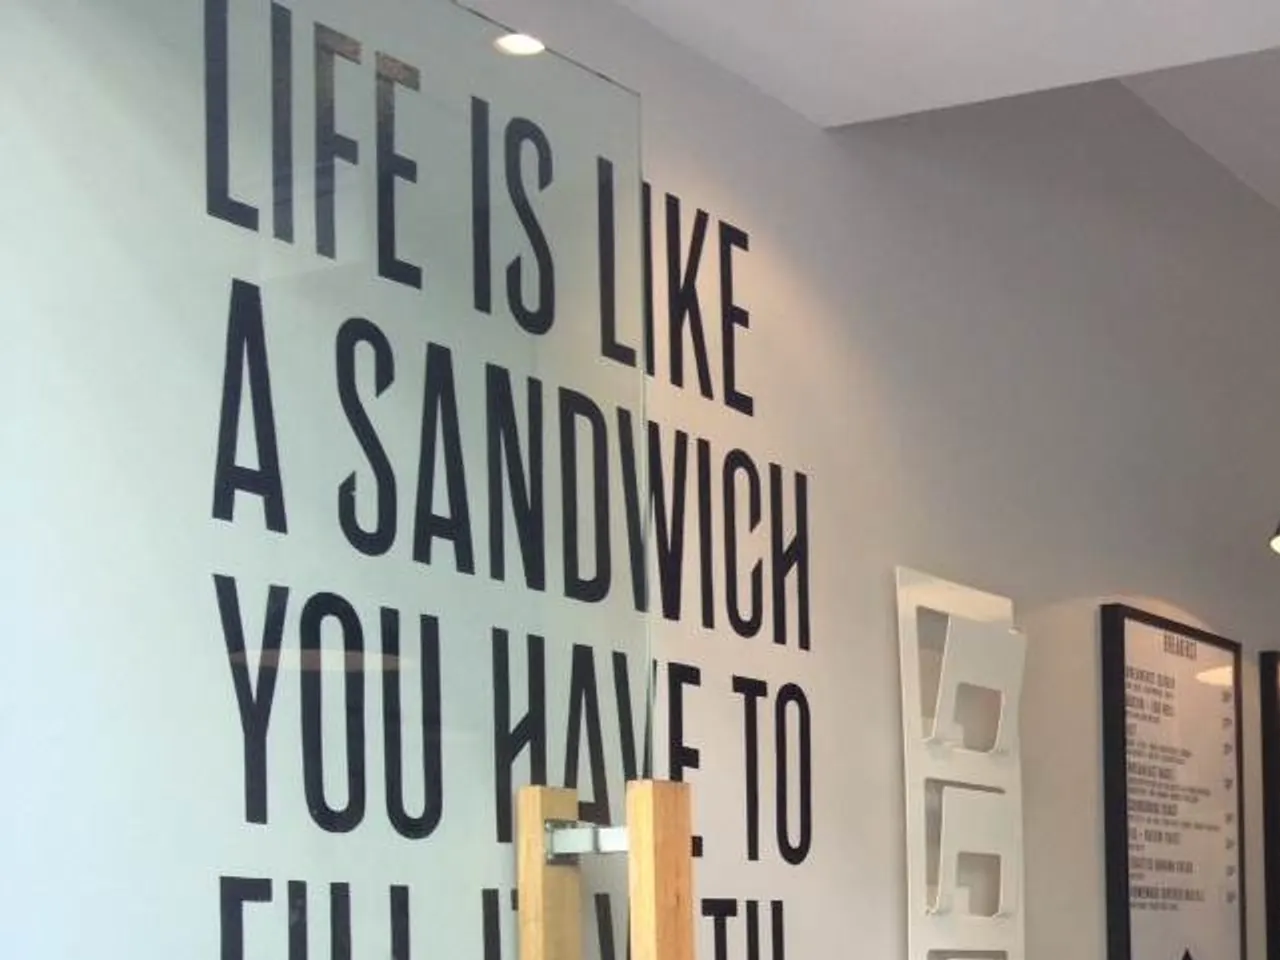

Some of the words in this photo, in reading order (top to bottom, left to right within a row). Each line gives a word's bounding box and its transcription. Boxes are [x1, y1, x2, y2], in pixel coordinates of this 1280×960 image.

[205, 0, 423, 290] LIFE
[471, 95, 556, 336] IS
[597, 155, 754, 418] LIKE
[212, 278, 288, 535] A
[336, 317, 811, 651] SANDWICH
[213, 574, 443, 840] YOU
[732, 674, 812, 865] TO
